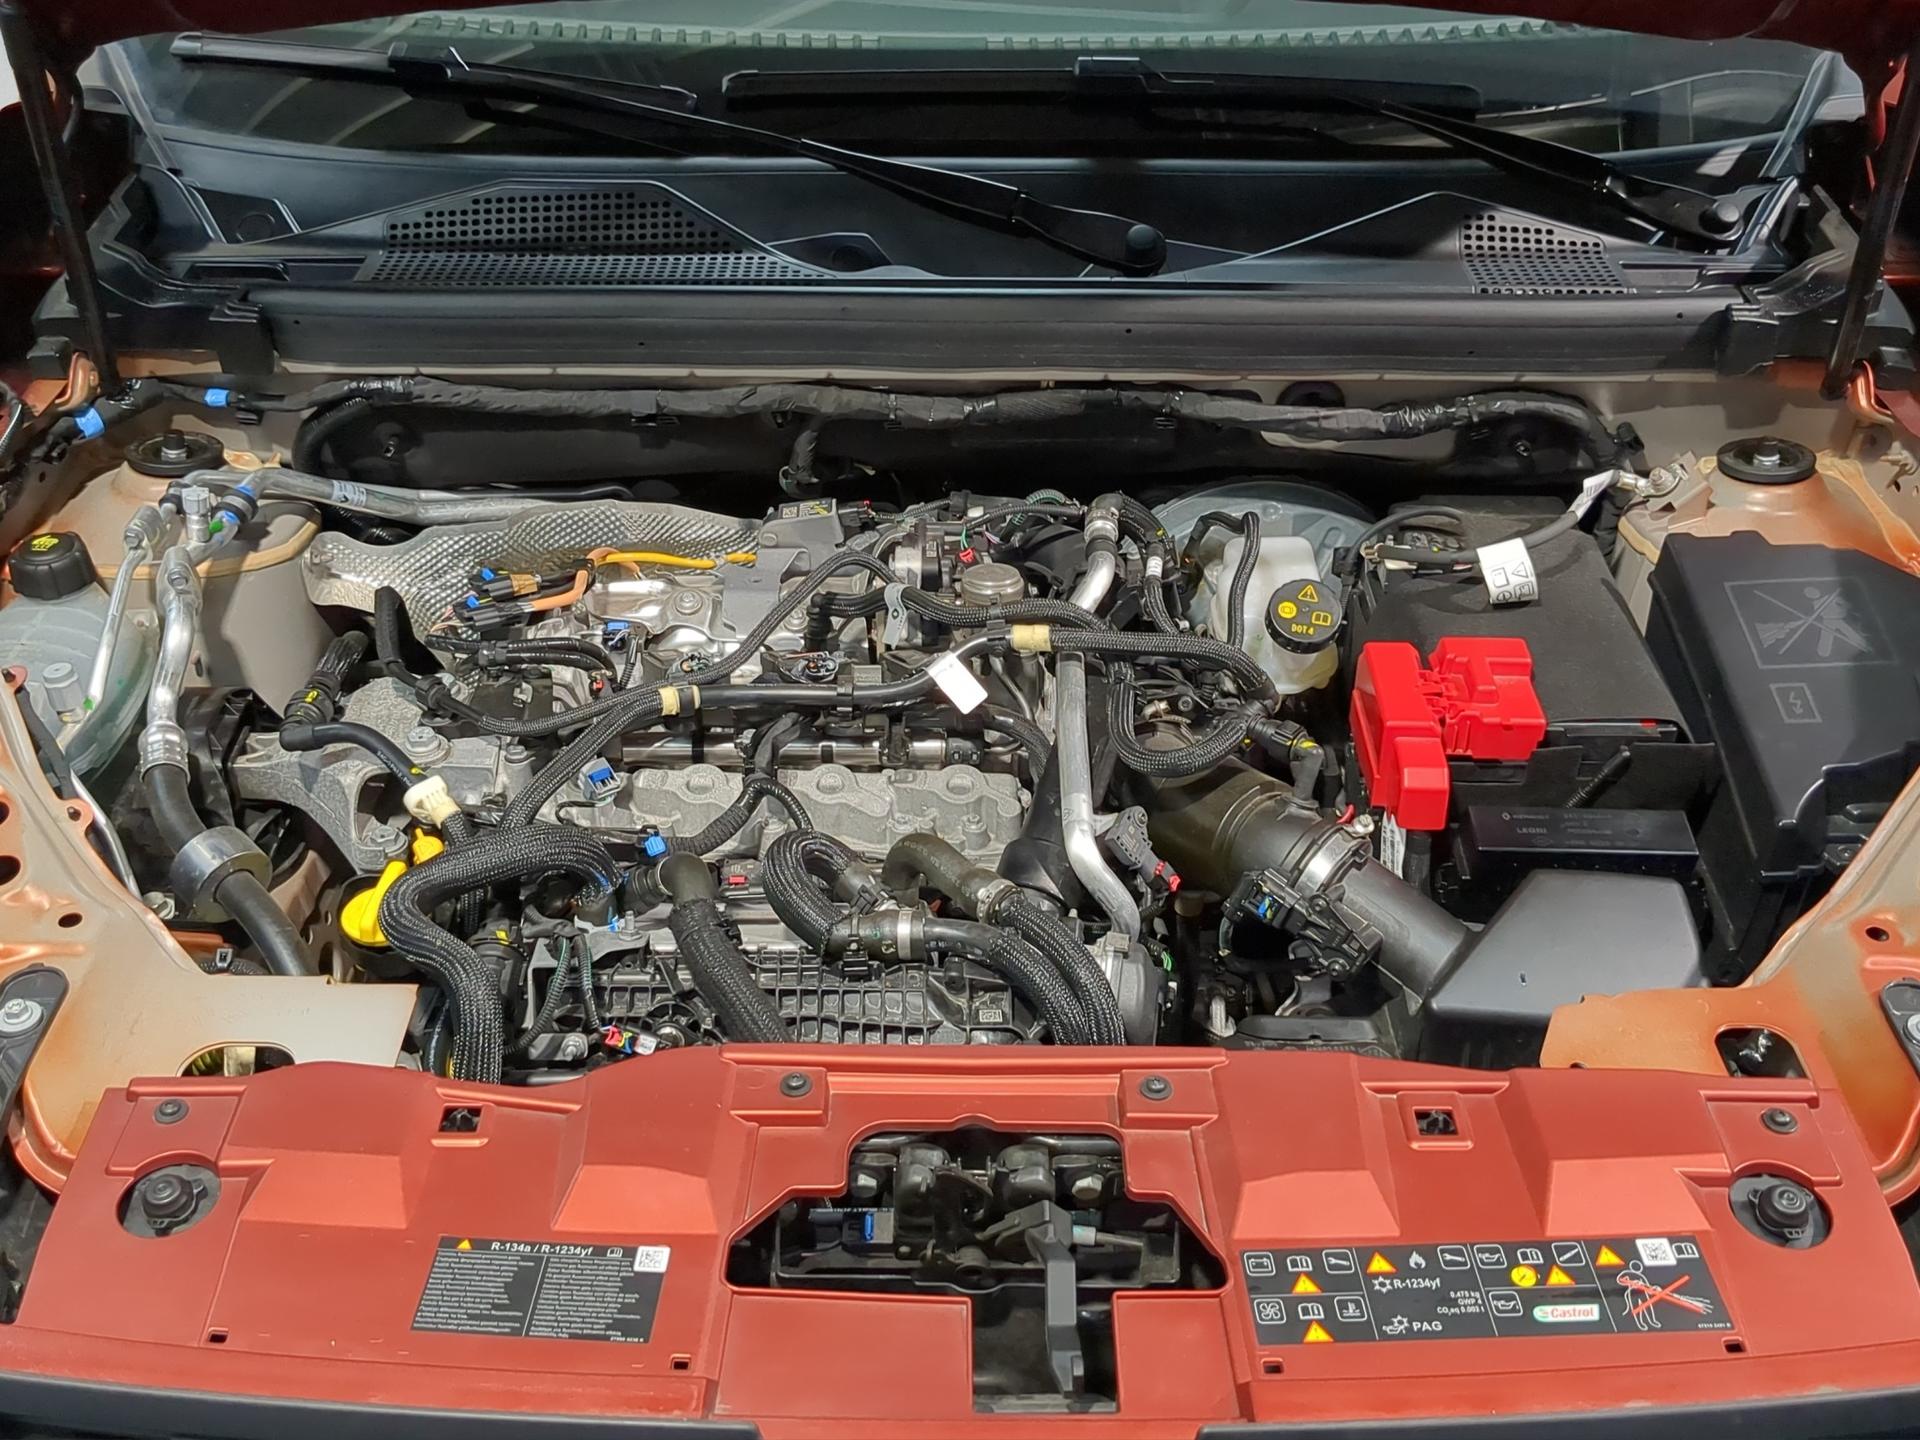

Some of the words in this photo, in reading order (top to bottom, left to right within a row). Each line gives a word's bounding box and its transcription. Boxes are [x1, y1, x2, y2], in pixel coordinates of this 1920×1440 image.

[491, 1241, 532, 1253] R-134a
[541, 1244, 594, 1257] R-1234yf
[1393, 1277, 1440, 1290] R-1234yf
[1550, 1306, 1595, 1319] Castrol
[1412, 1320, 1443, 1332] PAG
